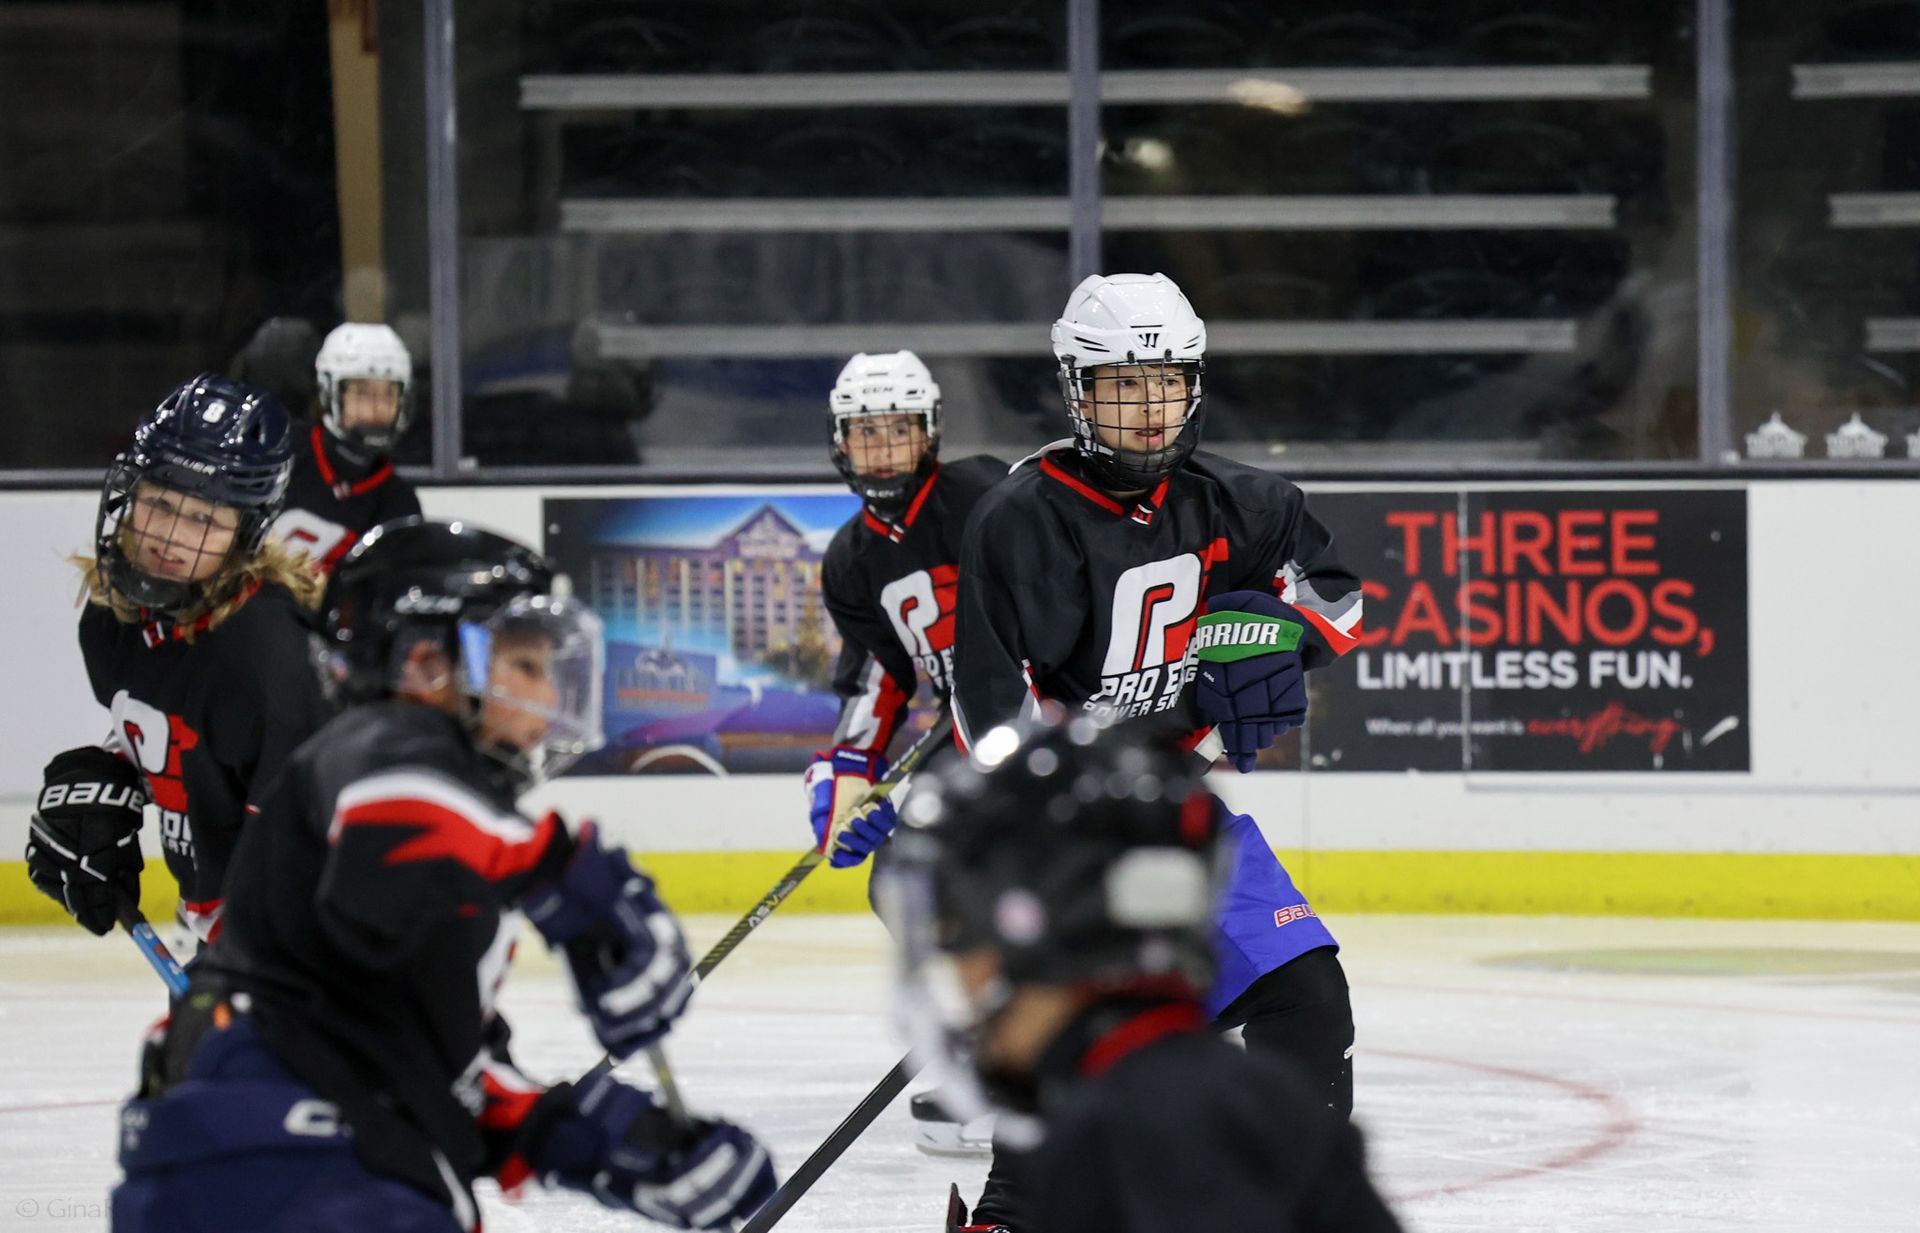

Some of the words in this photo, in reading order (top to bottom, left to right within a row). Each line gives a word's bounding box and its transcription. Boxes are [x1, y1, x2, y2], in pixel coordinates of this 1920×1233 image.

[862, 386, 894, 394] CCM
[1386, 509, 1661, 577] THREE
[1196, 622, 1281, 651] RRIOR
[1362, 577, 1716, 657] CASINOS,
[1088, 667, 1161, 706] PRO
[1356, 650, 1579, 690] LIMITLESS
[1588, 650, 1694, 690] FUN.
[1526, 702, 1678, 753] everything
[39, 781, 144, 812] BAUE
